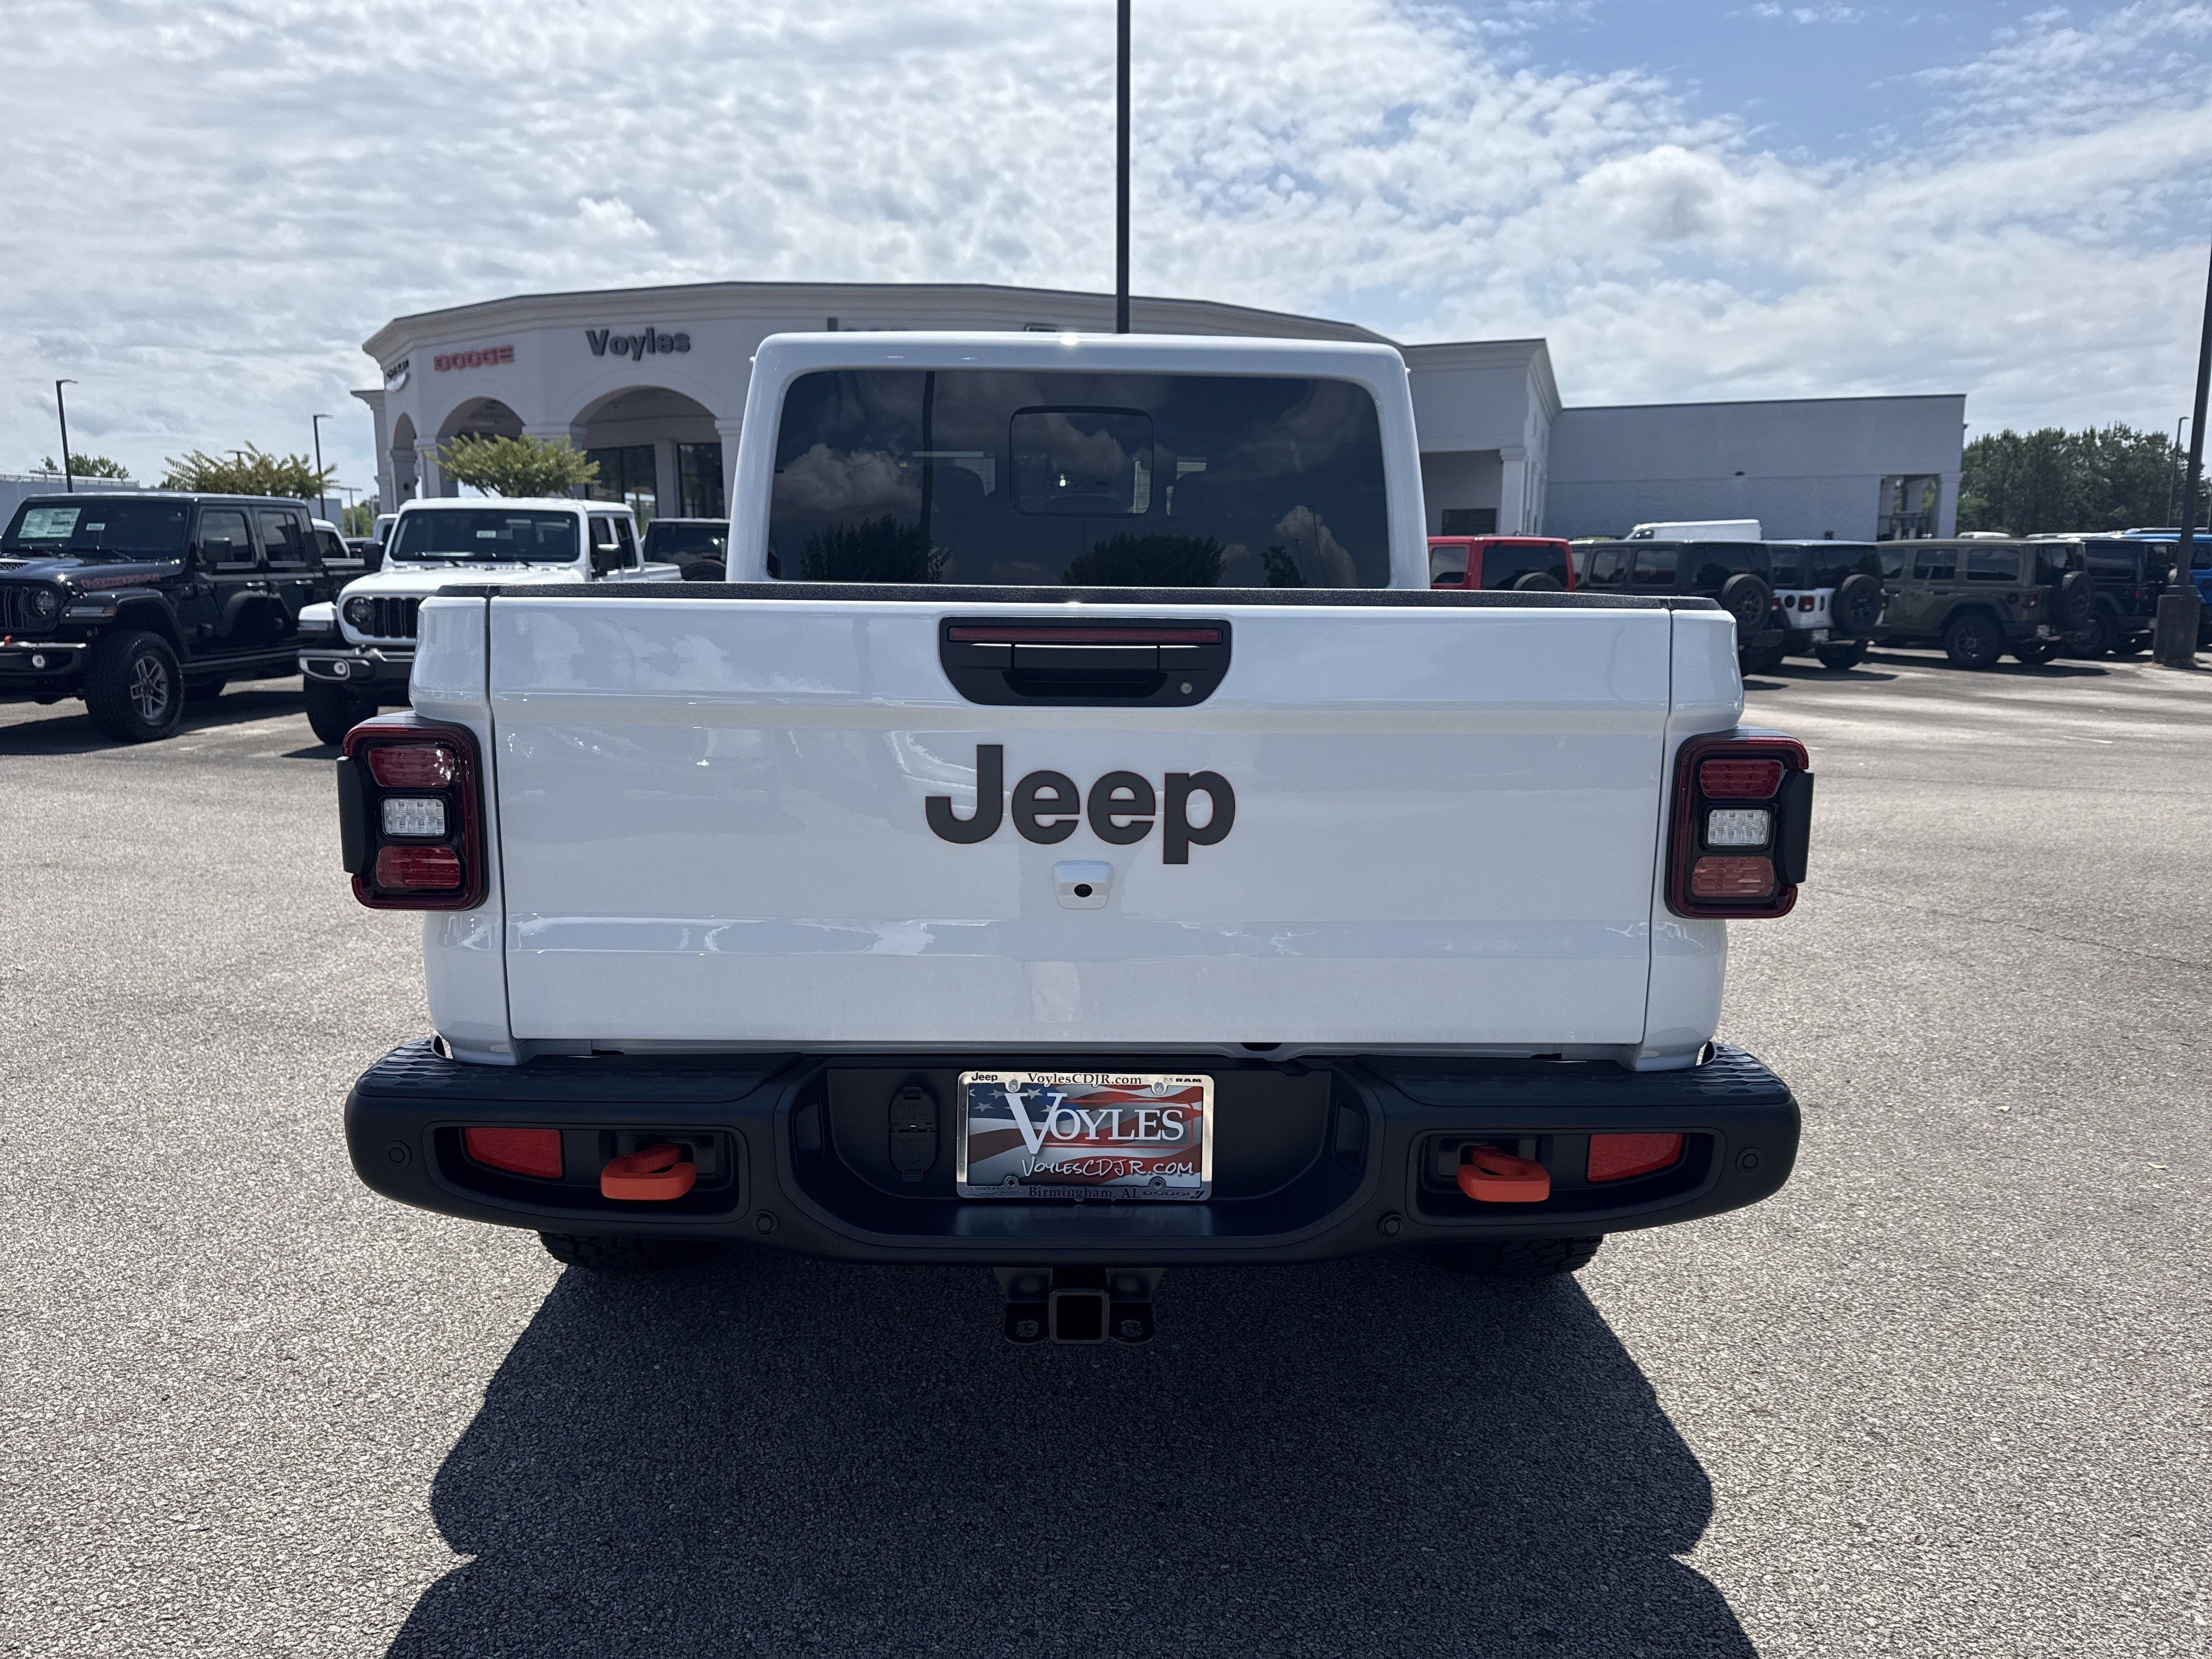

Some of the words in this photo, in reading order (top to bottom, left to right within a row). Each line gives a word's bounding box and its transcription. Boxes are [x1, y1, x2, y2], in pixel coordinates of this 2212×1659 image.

[585, 326, 691, 362] Voyles
[433, 345, 515, 371] DODGE
[925, 744, 1236, 865] Jeep
[971, 1072, 998, 1082] Jeep
[1027, 1073, 1142, 1086] VoylesCDJR.com
[1028, 1186, 1116, 1200] Birmingham,
[1121, 1188, 1140, 1199] AL
